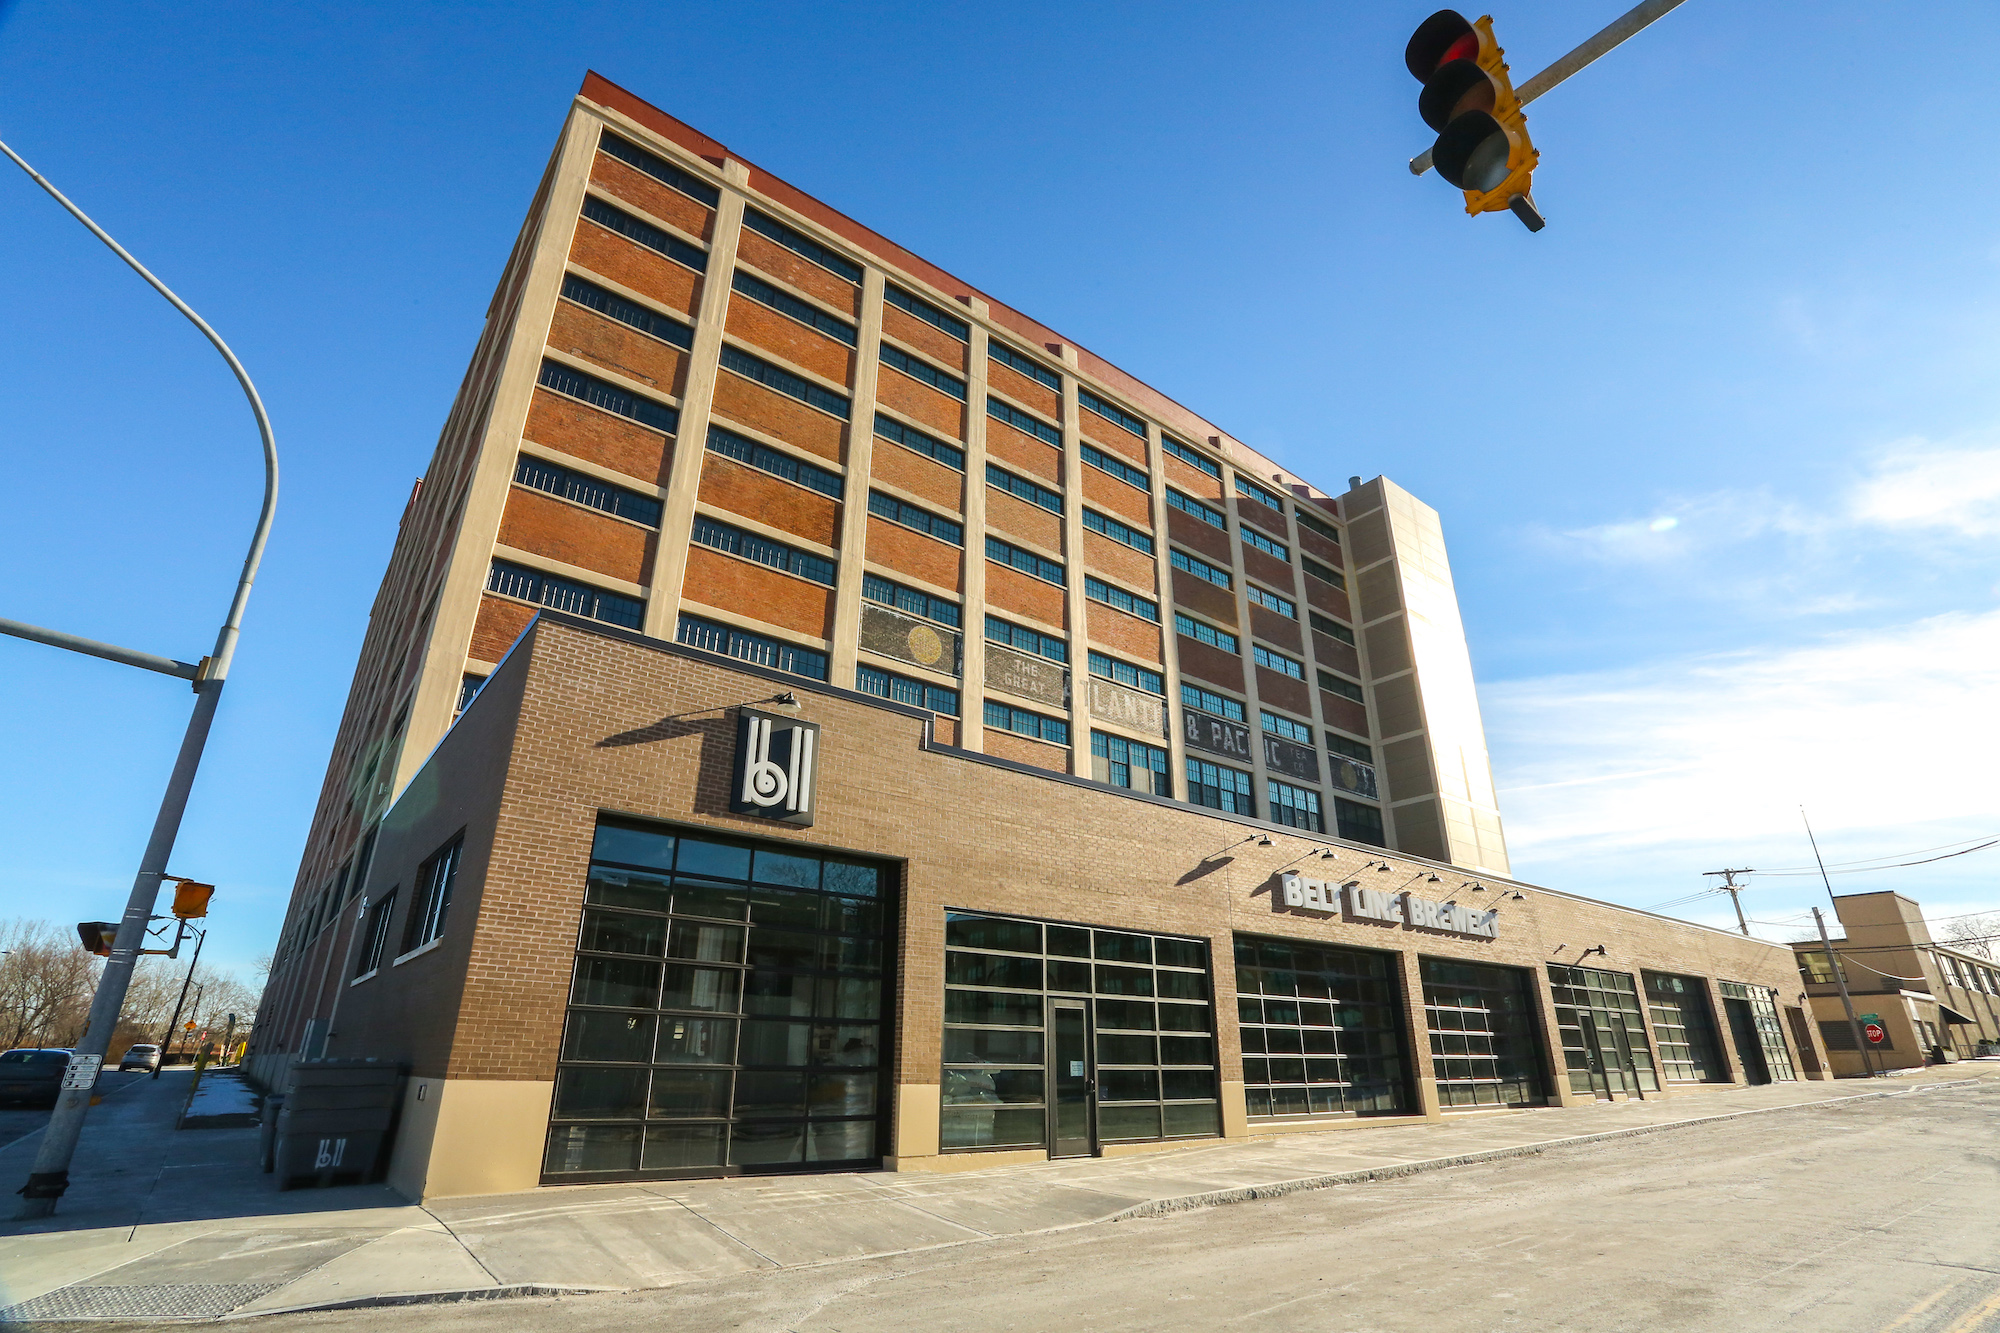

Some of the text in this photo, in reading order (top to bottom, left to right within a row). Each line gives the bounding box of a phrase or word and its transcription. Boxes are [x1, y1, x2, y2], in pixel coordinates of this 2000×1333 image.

[1014, 659, 1038, 677] THE
[1004, 672, 1045, 695] GREAT
[1187, 714, 1200, 741] &
[1289, 746, 1307, 761] TEA
[1281, 873, 1499, 939] BELT LINE BREWERY
[1866, 1029, 1881, 1038] STOP
